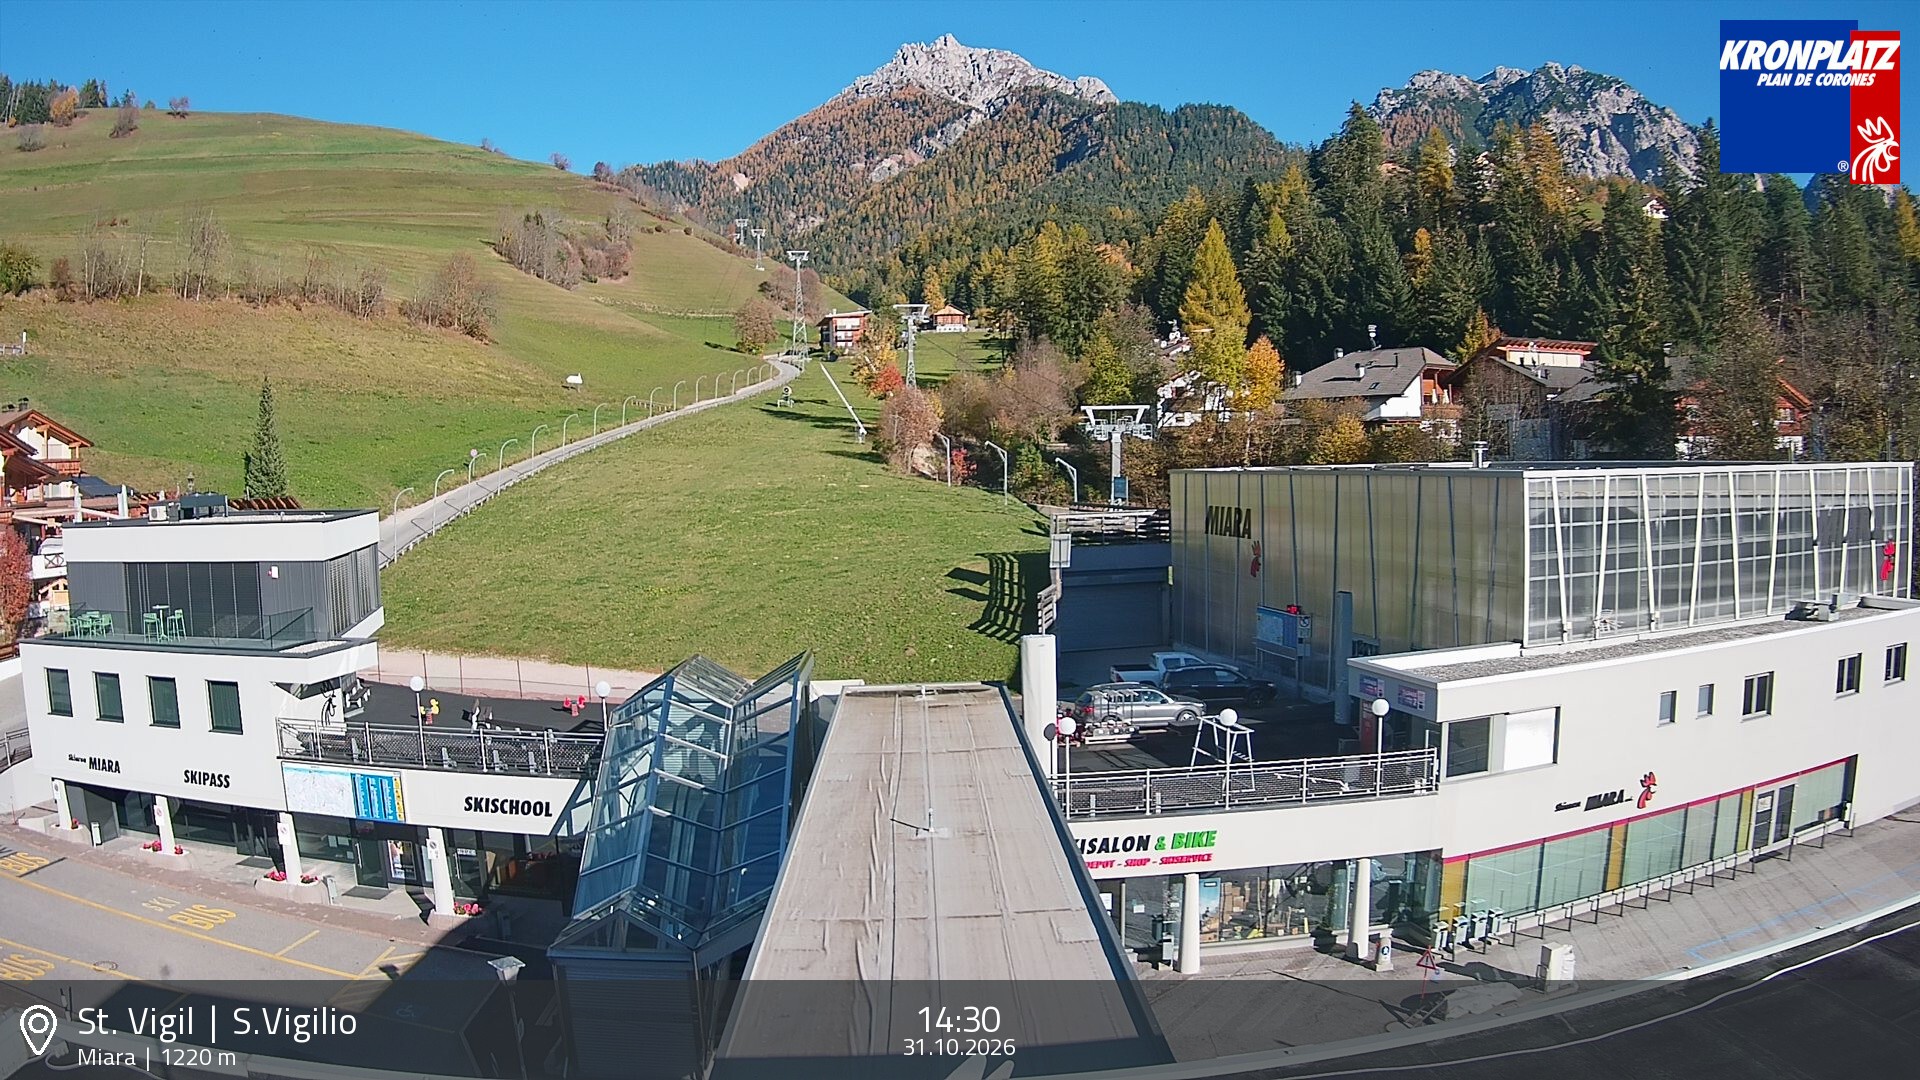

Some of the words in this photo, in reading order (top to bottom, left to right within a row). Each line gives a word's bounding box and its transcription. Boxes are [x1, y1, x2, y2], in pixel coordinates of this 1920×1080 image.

[1204, 505, 1252, 539] MIARA
[89, 757, 121, 773] MIARA
[184, 769, 230, 788] SKIPASS
[464, 796, 552, 817] SKISCHOOL
[1154, 836, 1166, 850] &
[1171, 830, 1217, 849] BIKE
[0, 852, 49, 872] BUS
[168, 904, 237, 930] BUS
